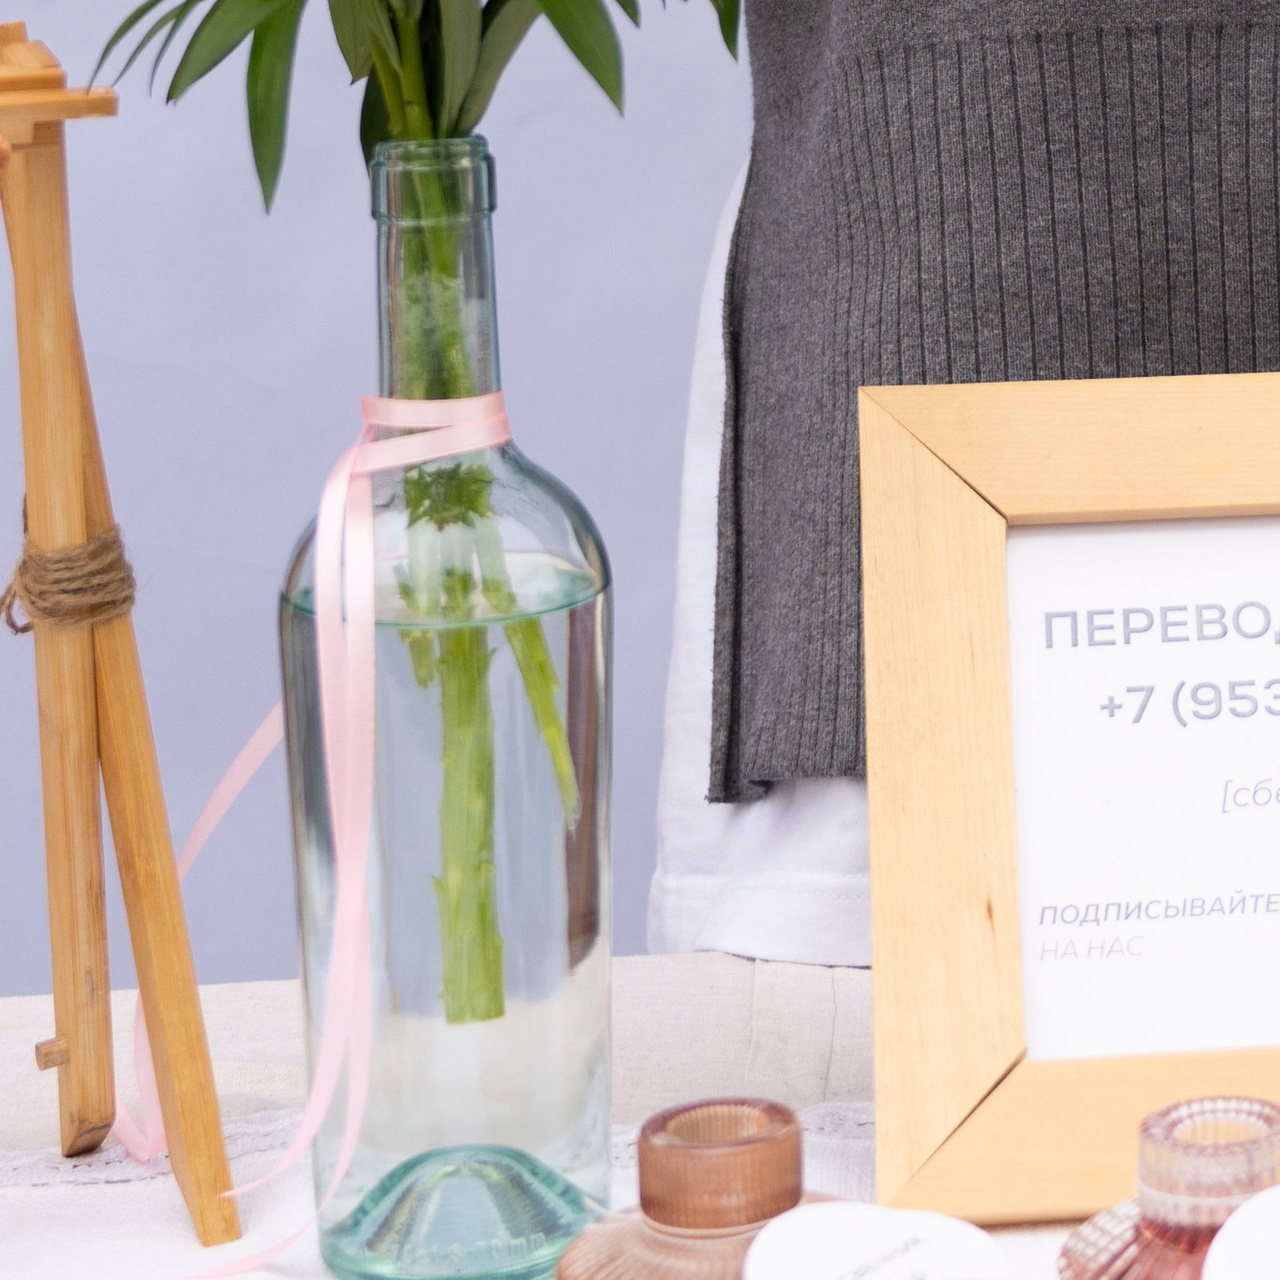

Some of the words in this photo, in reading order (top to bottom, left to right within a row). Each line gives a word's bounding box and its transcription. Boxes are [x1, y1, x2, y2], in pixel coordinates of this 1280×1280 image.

[1099, 684, 1156, 725] +7
[1039, 939, 1080, 962] НА
[1085, 934, 1145, 959] НАС
